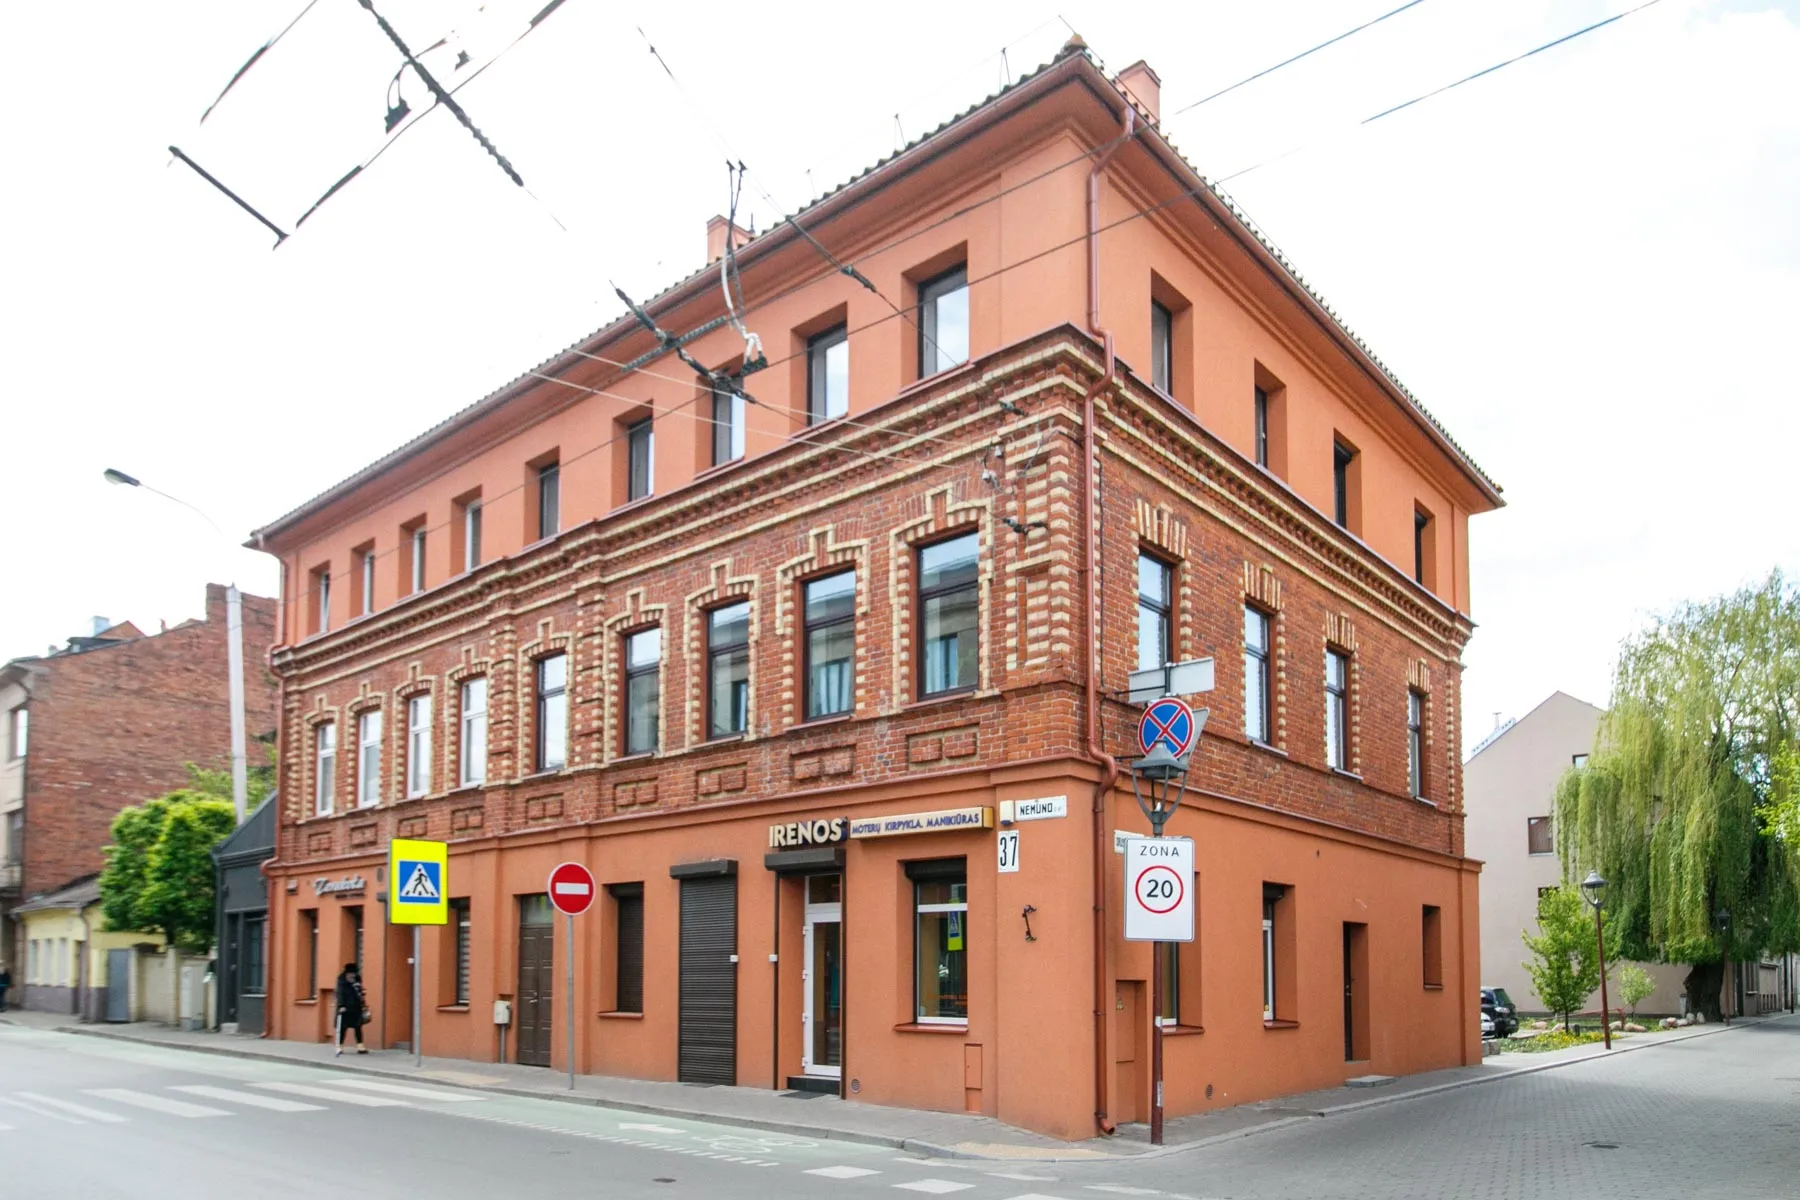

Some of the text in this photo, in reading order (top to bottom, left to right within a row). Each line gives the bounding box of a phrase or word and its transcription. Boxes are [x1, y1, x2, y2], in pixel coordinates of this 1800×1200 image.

[1020, 803, 1053, 816] NEMUNO
[768, 818, 843, 847] IRENOS
[852, 823, 881, 834] MOTERŲ
[926, 813, 980, 827] MANIKIŪRAS
[1000, 835, 1018, 867] 37
[1140, 845, 1180, 857] ZONA
[1146, 879, 1173, 898] 20
